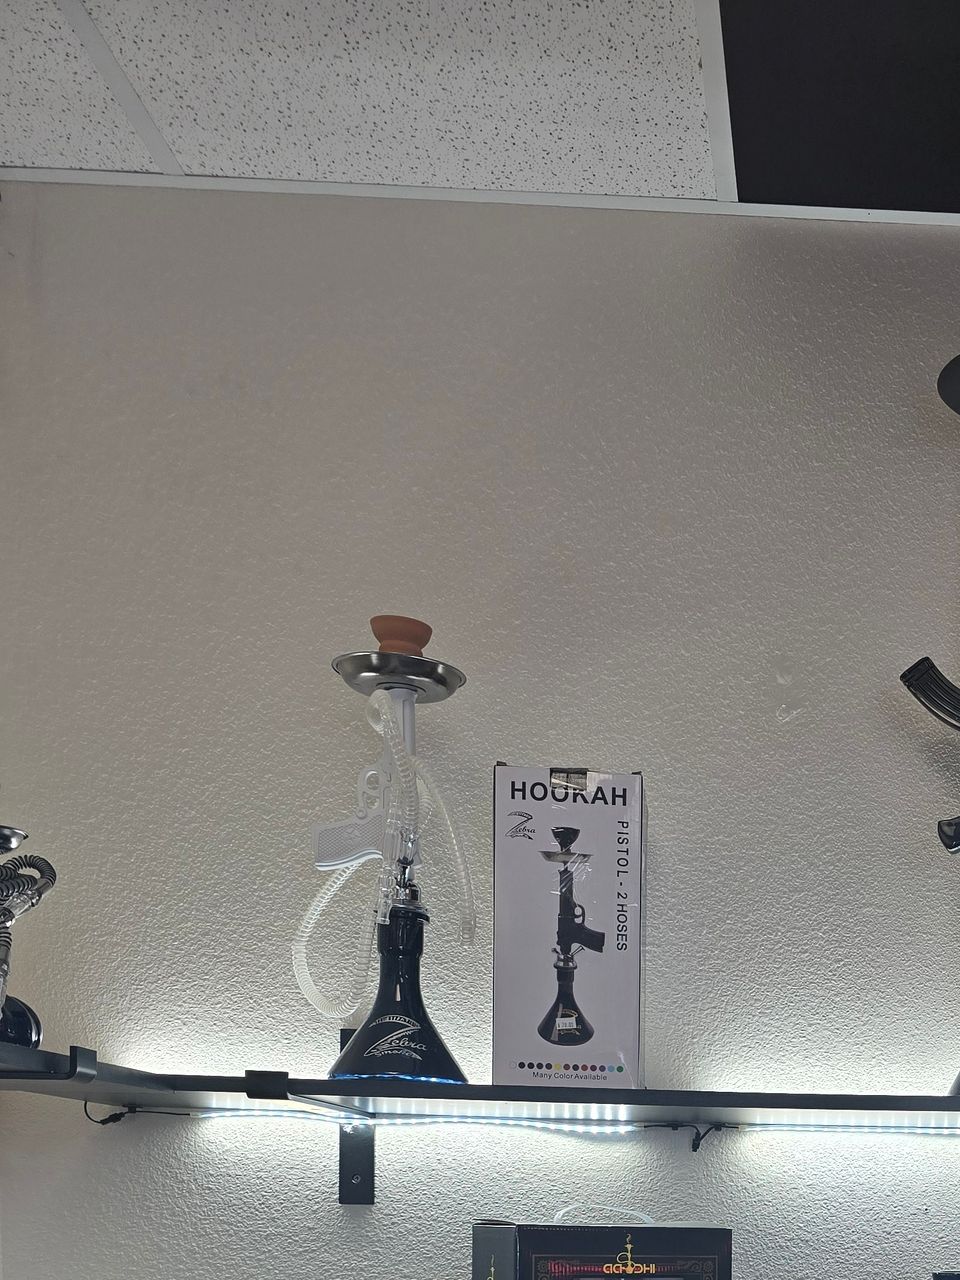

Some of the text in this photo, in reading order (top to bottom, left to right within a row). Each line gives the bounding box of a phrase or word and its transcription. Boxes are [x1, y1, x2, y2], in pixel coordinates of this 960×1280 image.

[511, 781, 627, 806] HOOKAH
[616, 820, 629, 877] PISTOL
[617, 892, 628, 900] 2
[616, 903, 628, 952] HOSES
[532, 1072, 552, 1080] Many
[553, 1072, 574, 1080] Color
